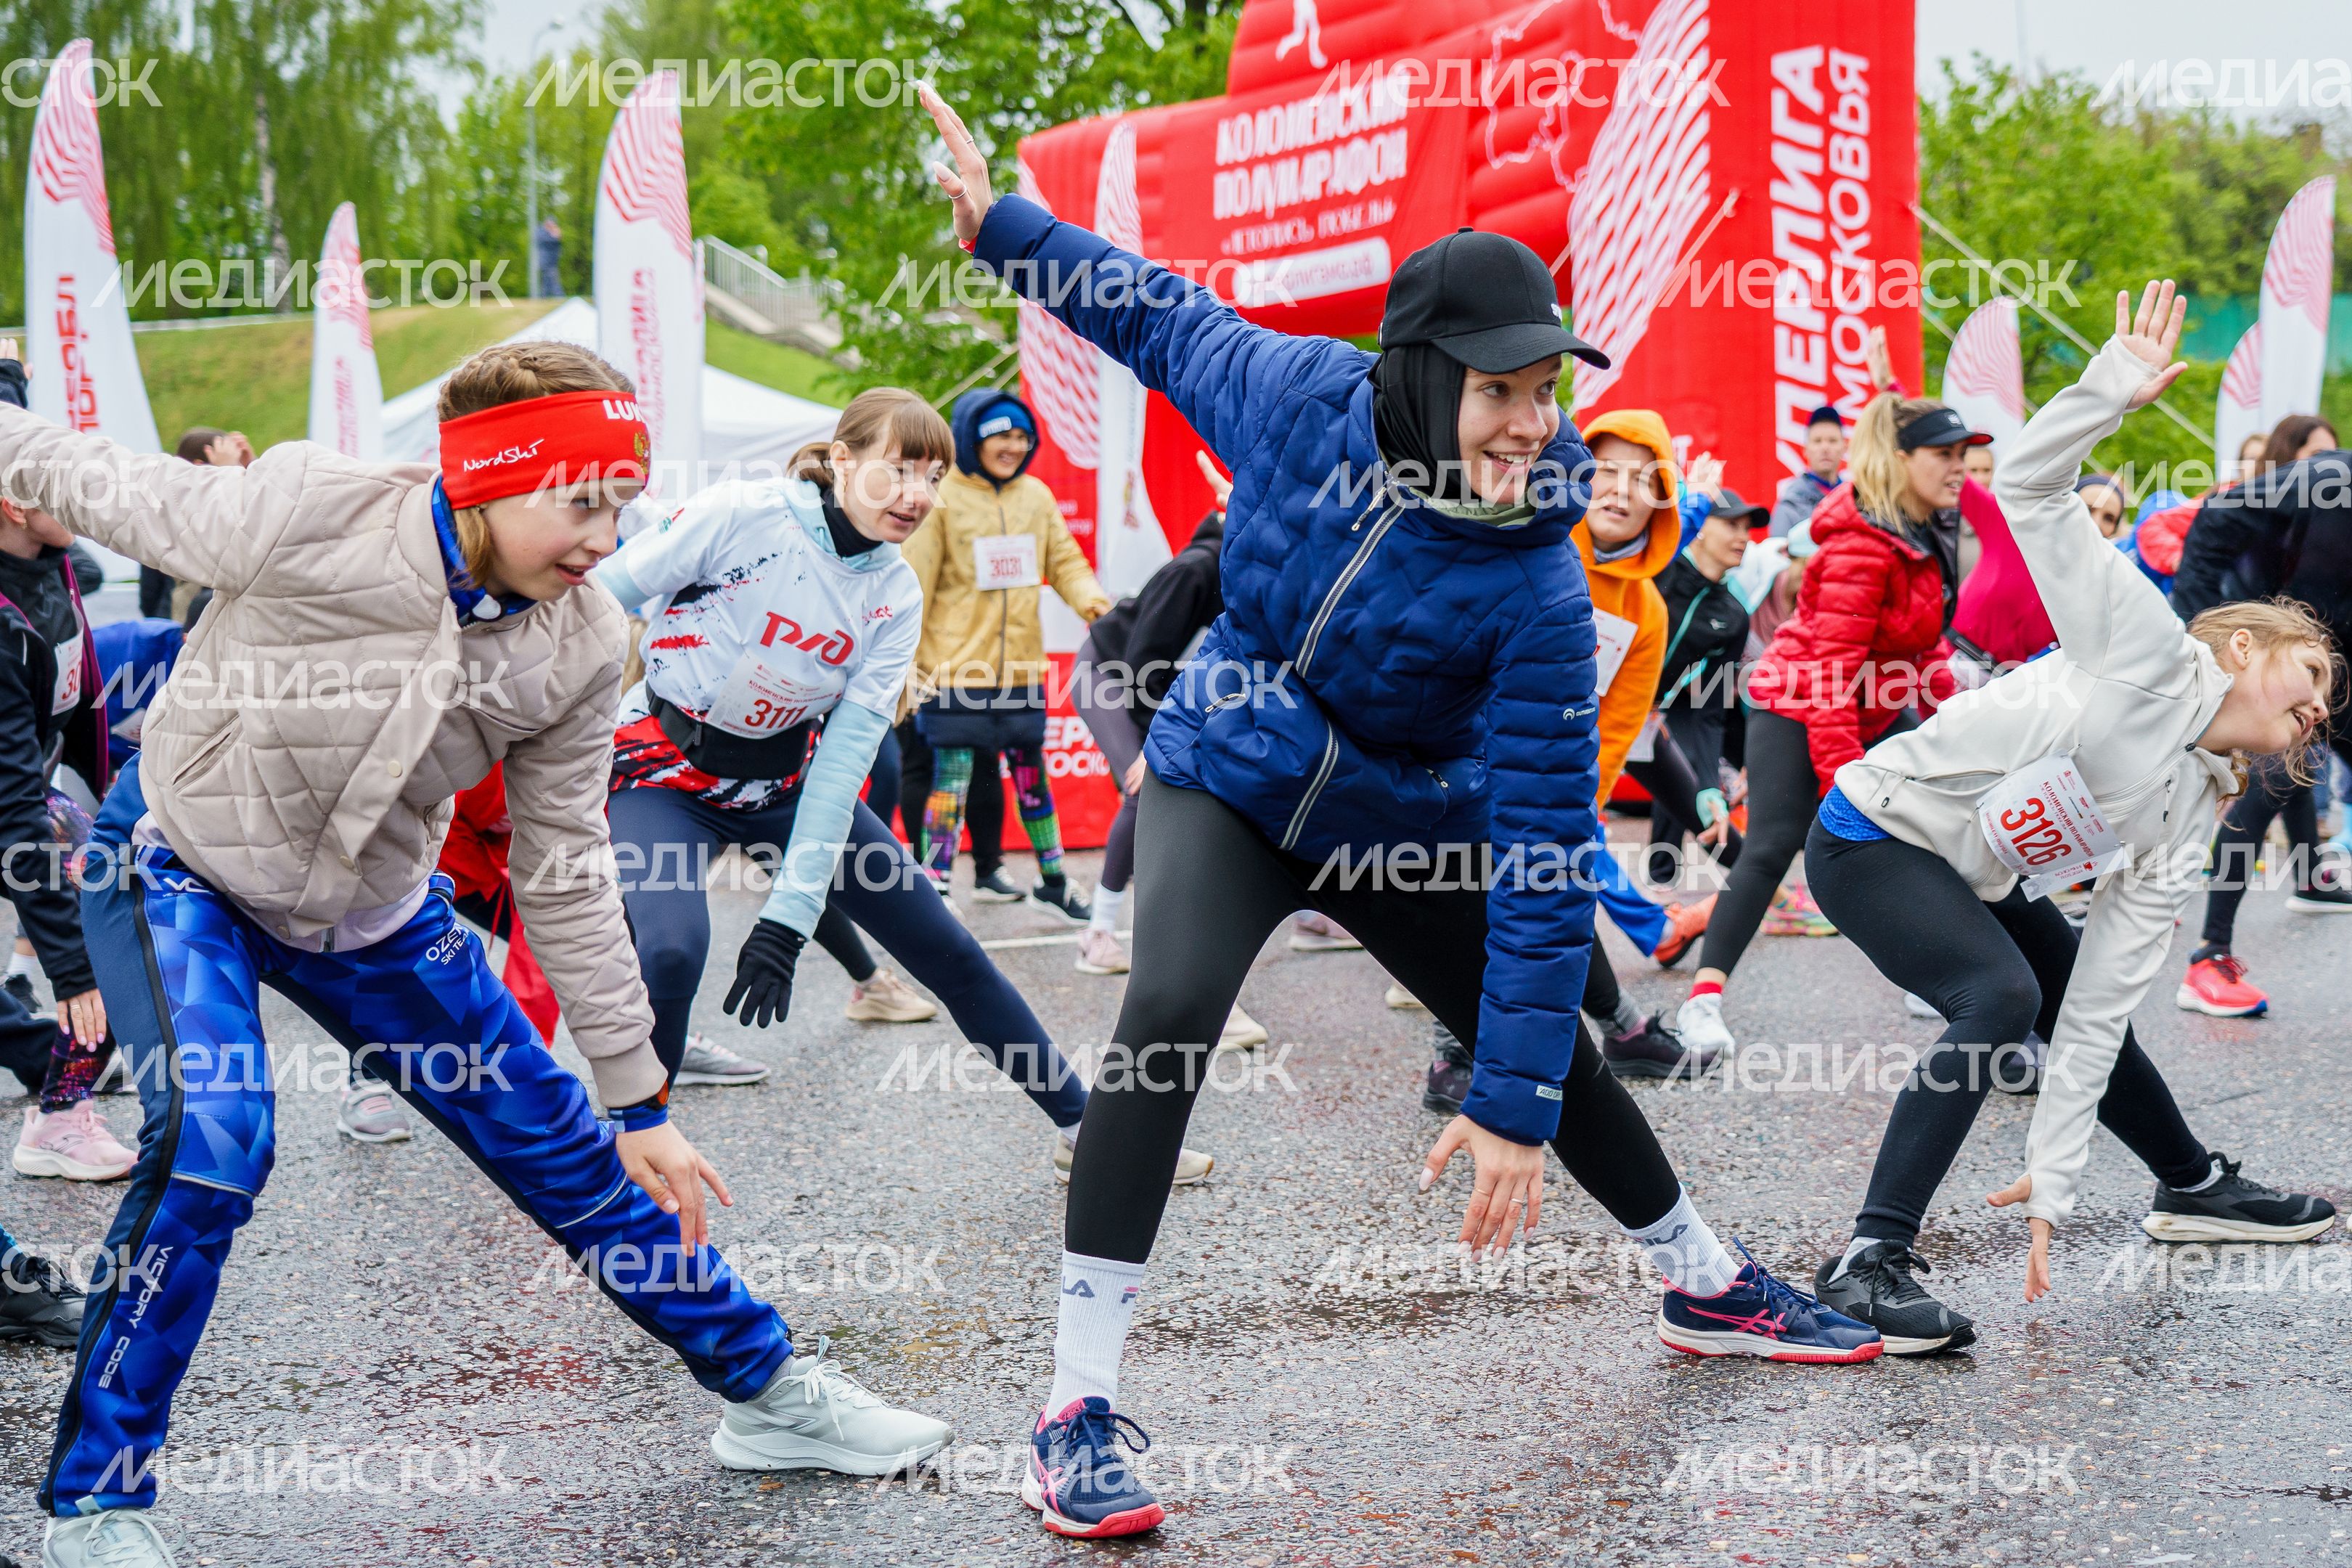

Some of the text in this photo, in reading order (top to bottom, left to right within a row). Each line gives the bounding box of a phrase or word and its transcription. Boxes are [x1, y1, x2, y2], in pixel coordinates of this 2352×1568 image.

[745, 698, 809, 730] 3111
[2000, 797, 2073, 866] 3126
[136, 1246, 174, 1329] VICTORY
[97, 1336, 131, 1389] CODE
